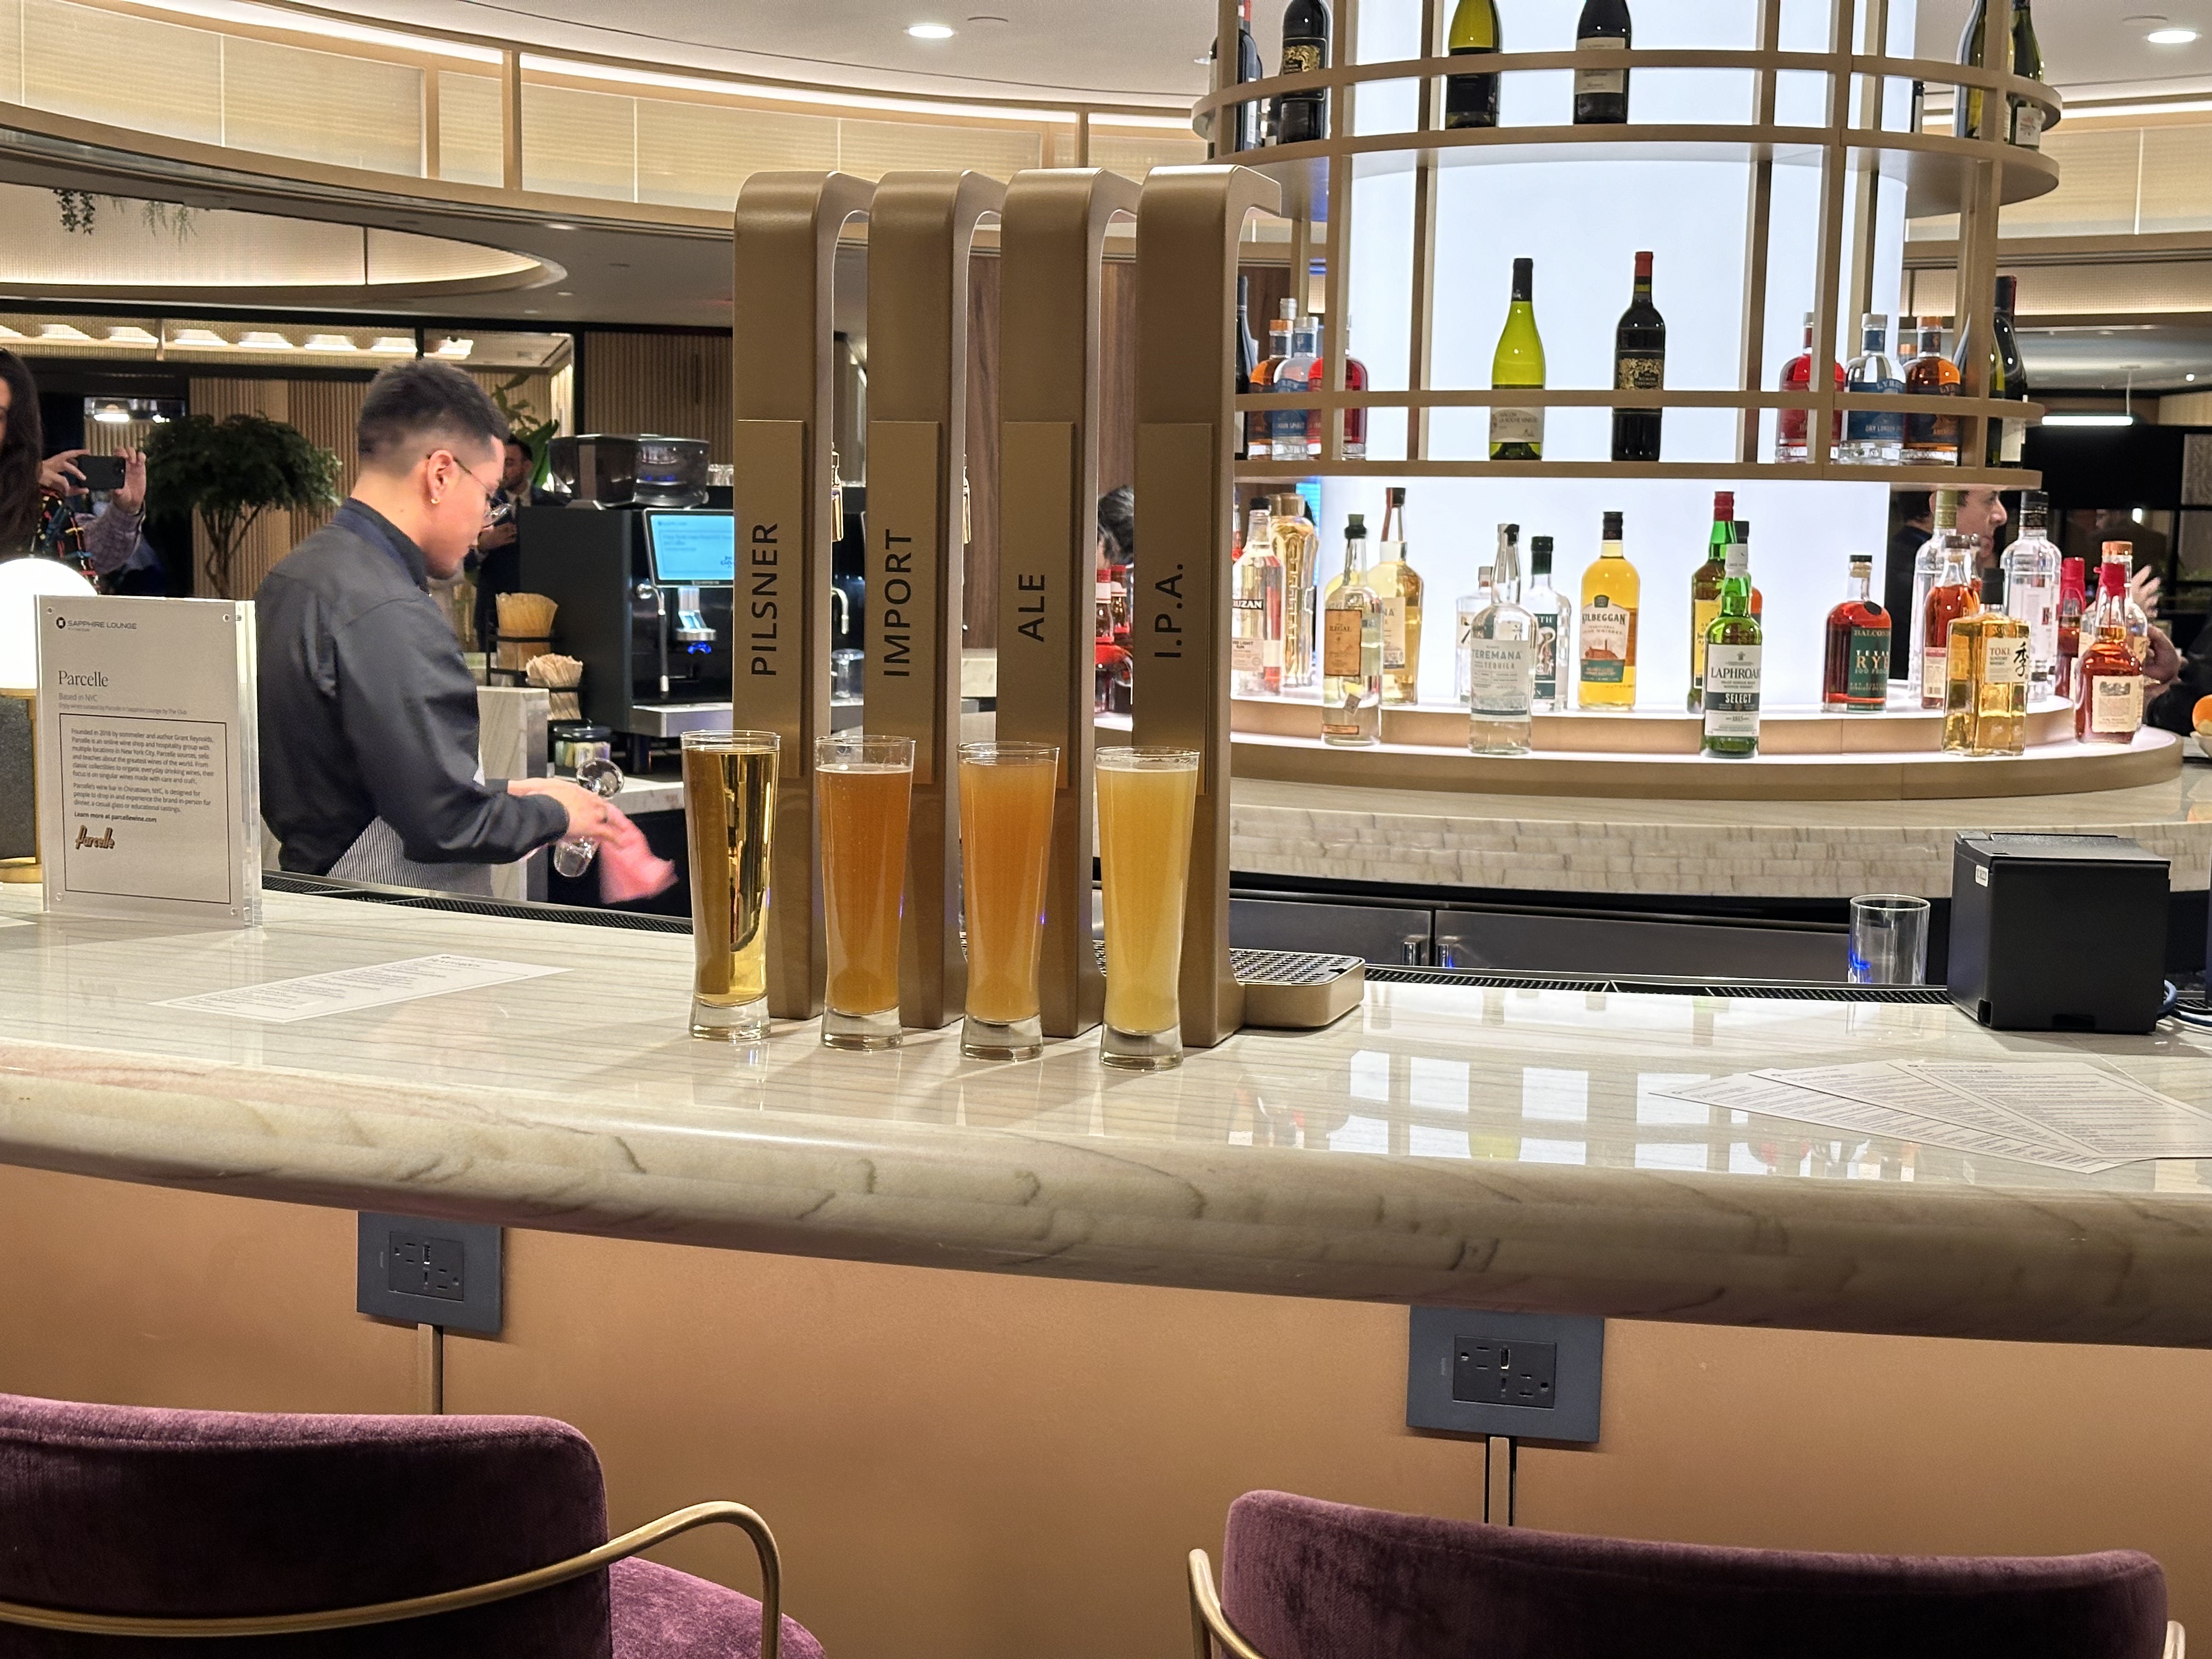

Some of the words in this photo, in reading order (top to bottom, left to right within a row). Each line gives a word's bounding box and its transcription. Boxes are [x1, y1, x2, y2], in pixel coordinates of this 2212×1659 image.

[751, 523, 778, 676] PILSNER
[883, 528, 912, 678] IMPORT
[1018, 573, 1046, 643] ALE
[1232, 600, 1262, 608] RUZAN
[1155, 563, 1184, 659] I.P.A.
[1582, 613, 1626, 625] KILBEGGAN
[1471, 649, 1521, 660] TEREMANA
[2013, 641, 2029, 676] 季
[1485, 661, 1514, 670] TEQUILA
[58, 670, 109, 687] Parcelle
[1725, 693, 1751, 704] SELECT
